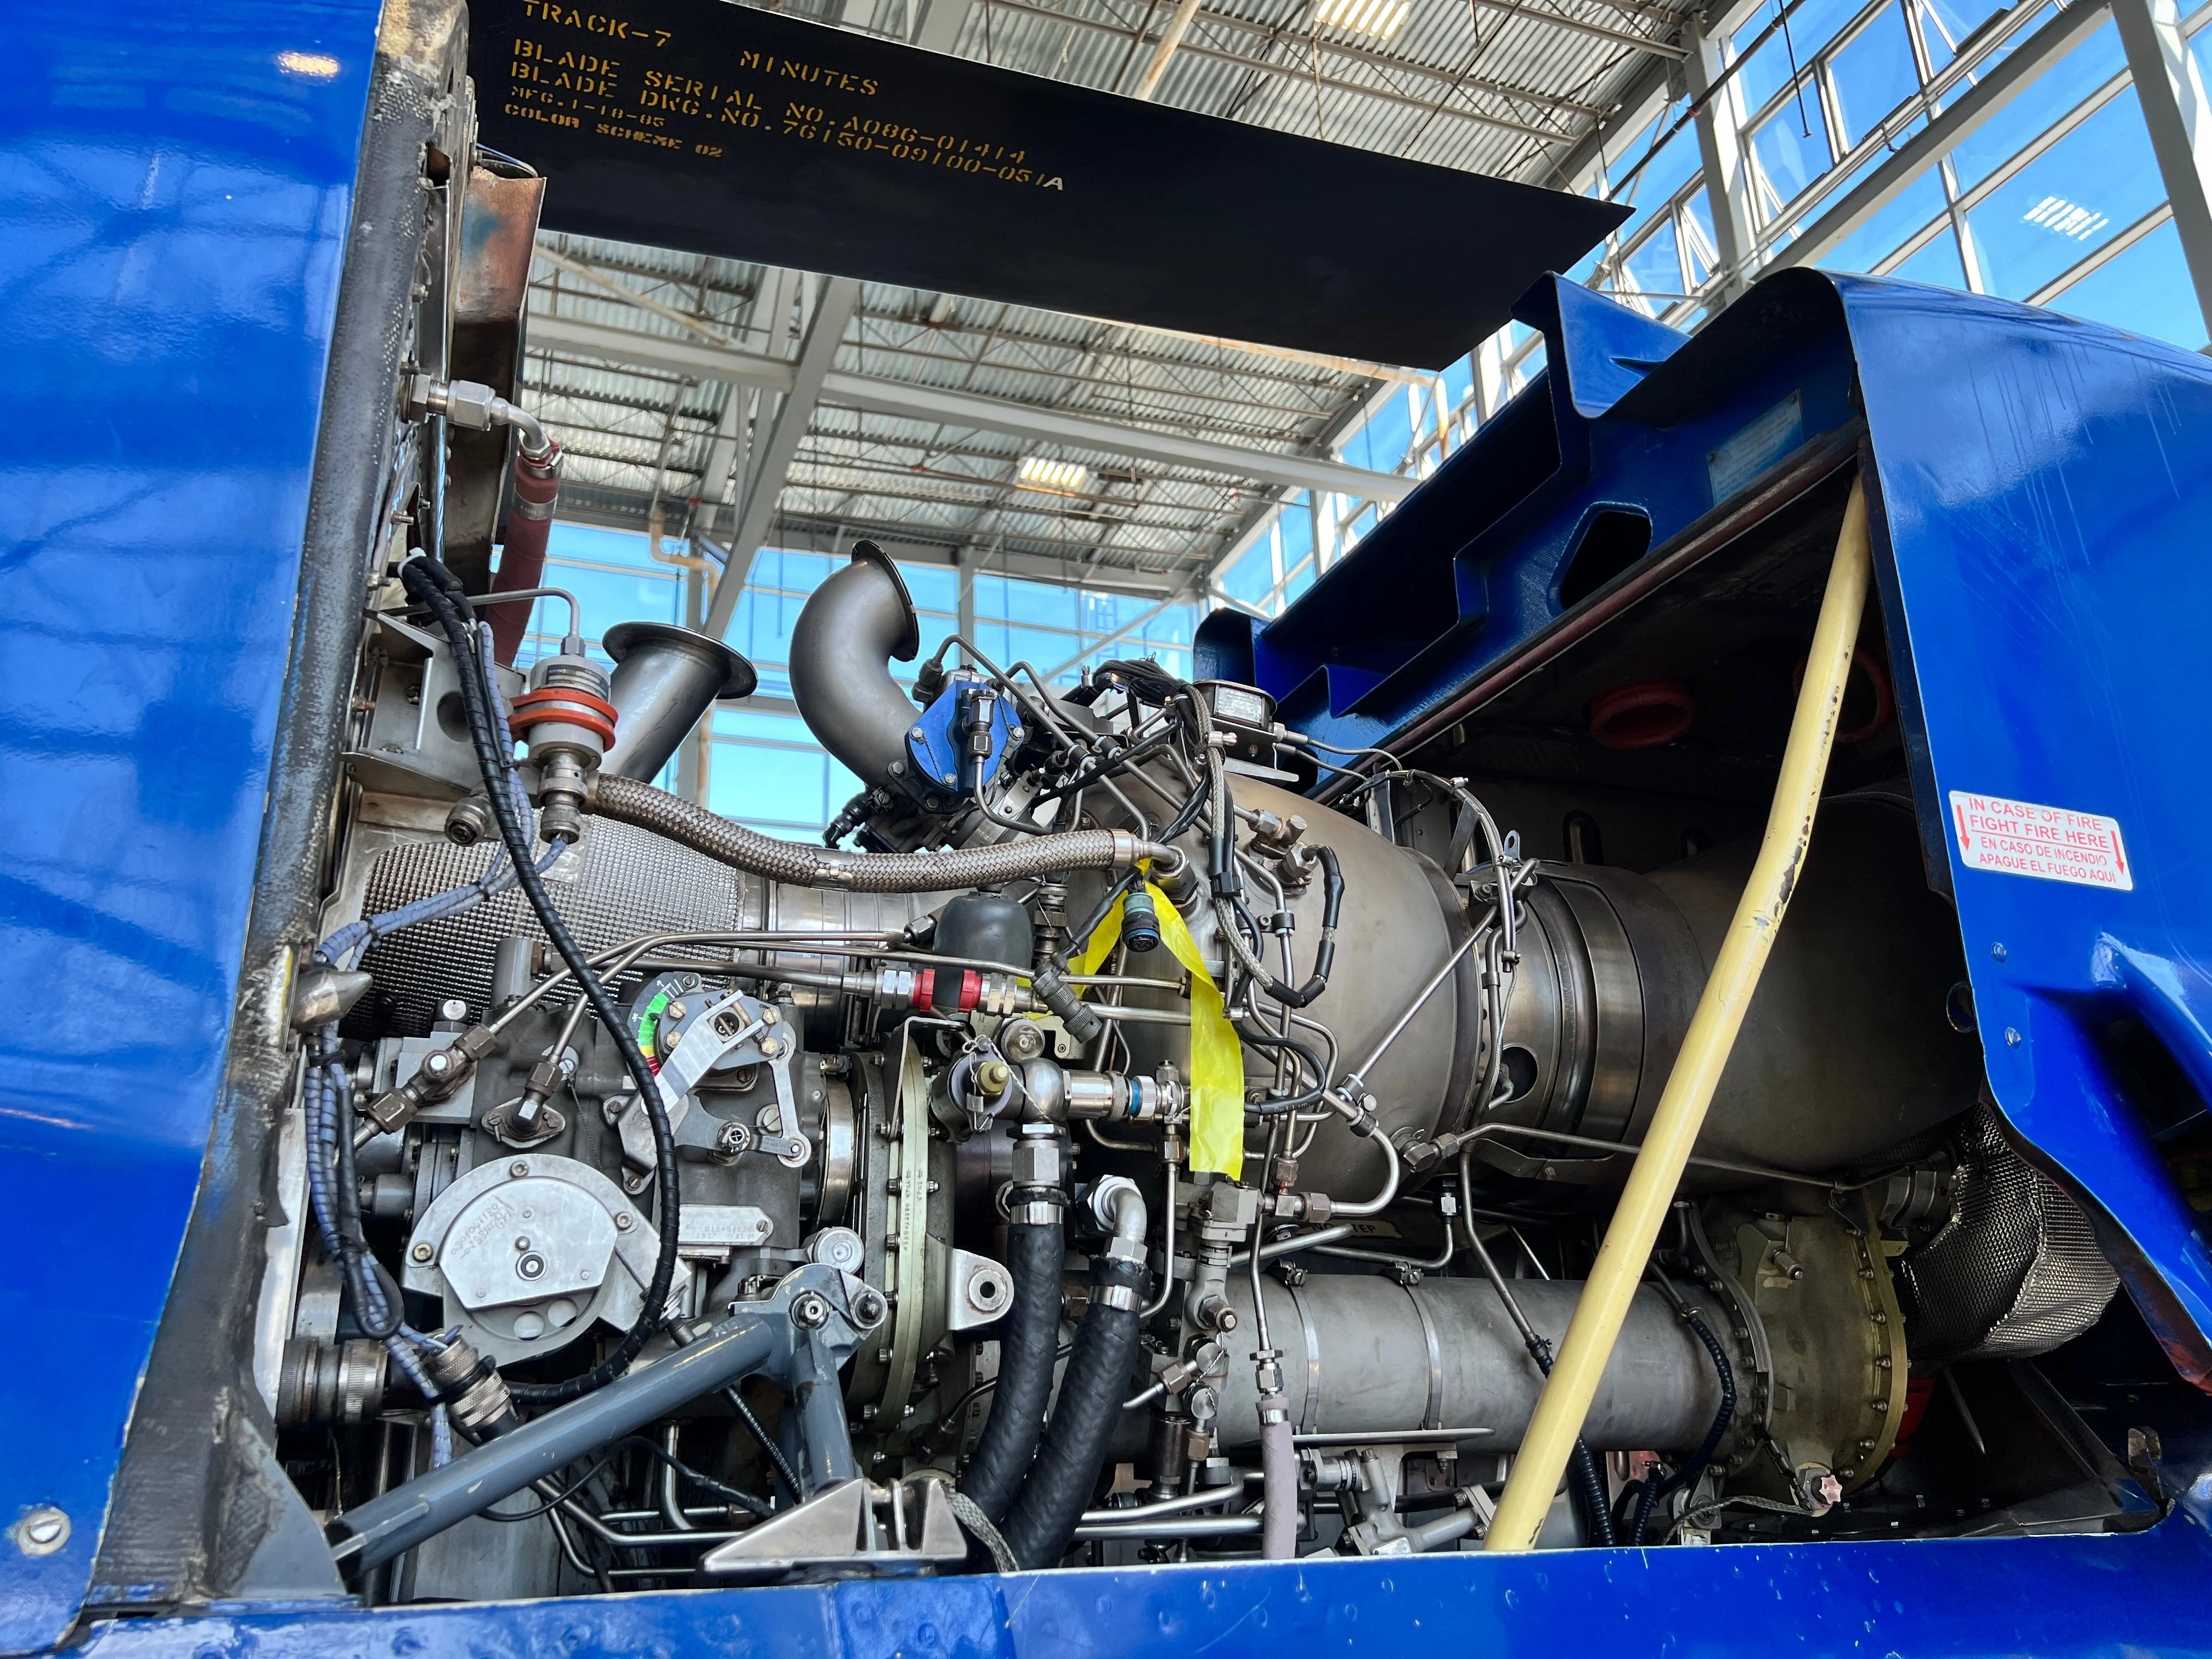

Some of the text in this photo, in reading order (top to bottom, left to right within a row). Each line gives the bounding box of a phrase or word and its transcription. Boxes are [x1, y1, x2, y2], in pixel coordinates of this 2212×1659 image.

[524, 0, 672, 47] TRACK-7
[512, 62, 617, 98] BLADE
[515, 39, 620, 78] BLADE
[645, 71, 762, 110] SERIAL
[740, 50, 878, 95] MINUTES
[505, 104, 724, 157] COLOR SCHEME 02
[1968, 797, 2103, 832] IN CASE OF FIRE
[1970, 815, 2109, 849] FIGHT FIRE HERE
[1979, 853, 2117, 884] APAGUE EL FUEGO AQUÍ
[1980, 837, 2108, 866] EN CASO DE INCENDIO
